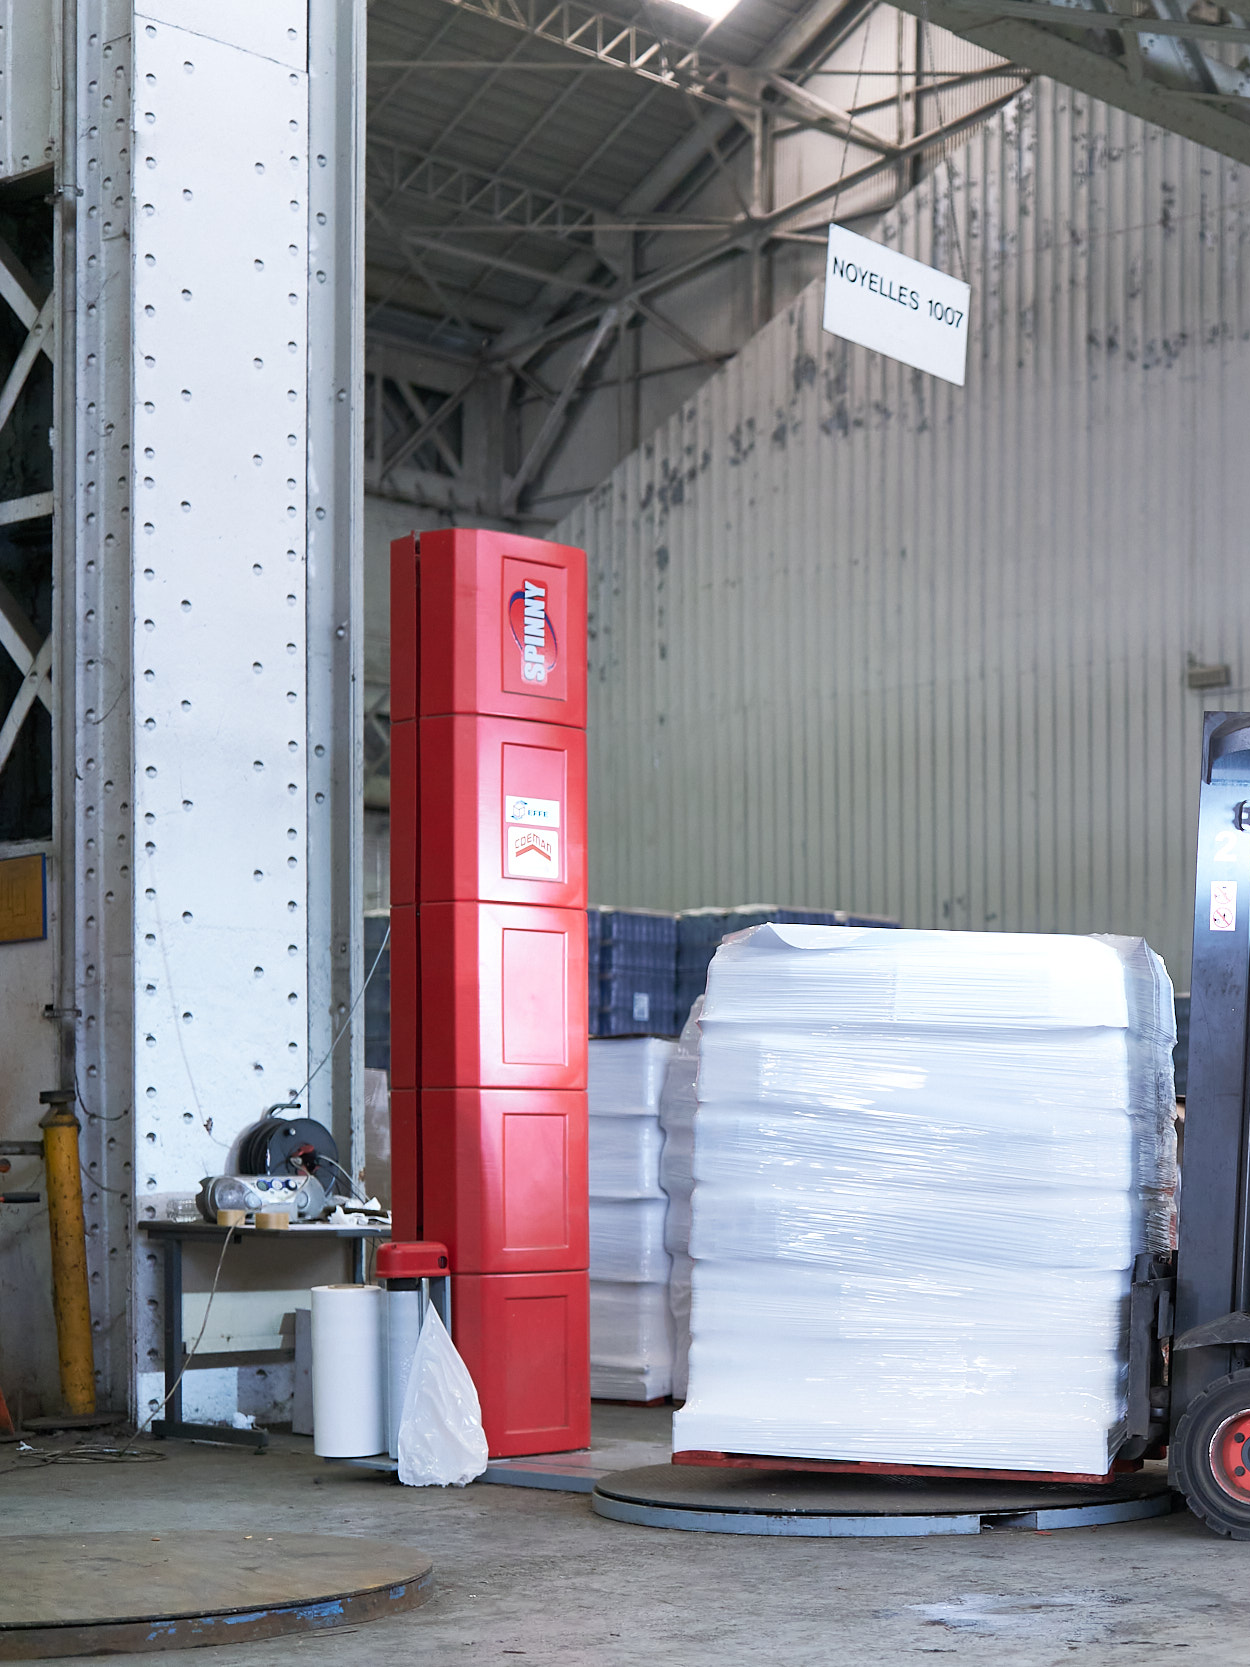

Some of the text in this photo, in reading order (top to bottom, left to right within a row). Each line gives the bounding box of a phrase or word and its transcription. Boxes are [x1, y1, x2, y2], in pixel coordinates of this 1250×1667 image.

[833, 256, 963, 328] NOYELLES 1007
[524, 580, 545, 682] SPINNY
[1213, 830, 1237, 862] 2
